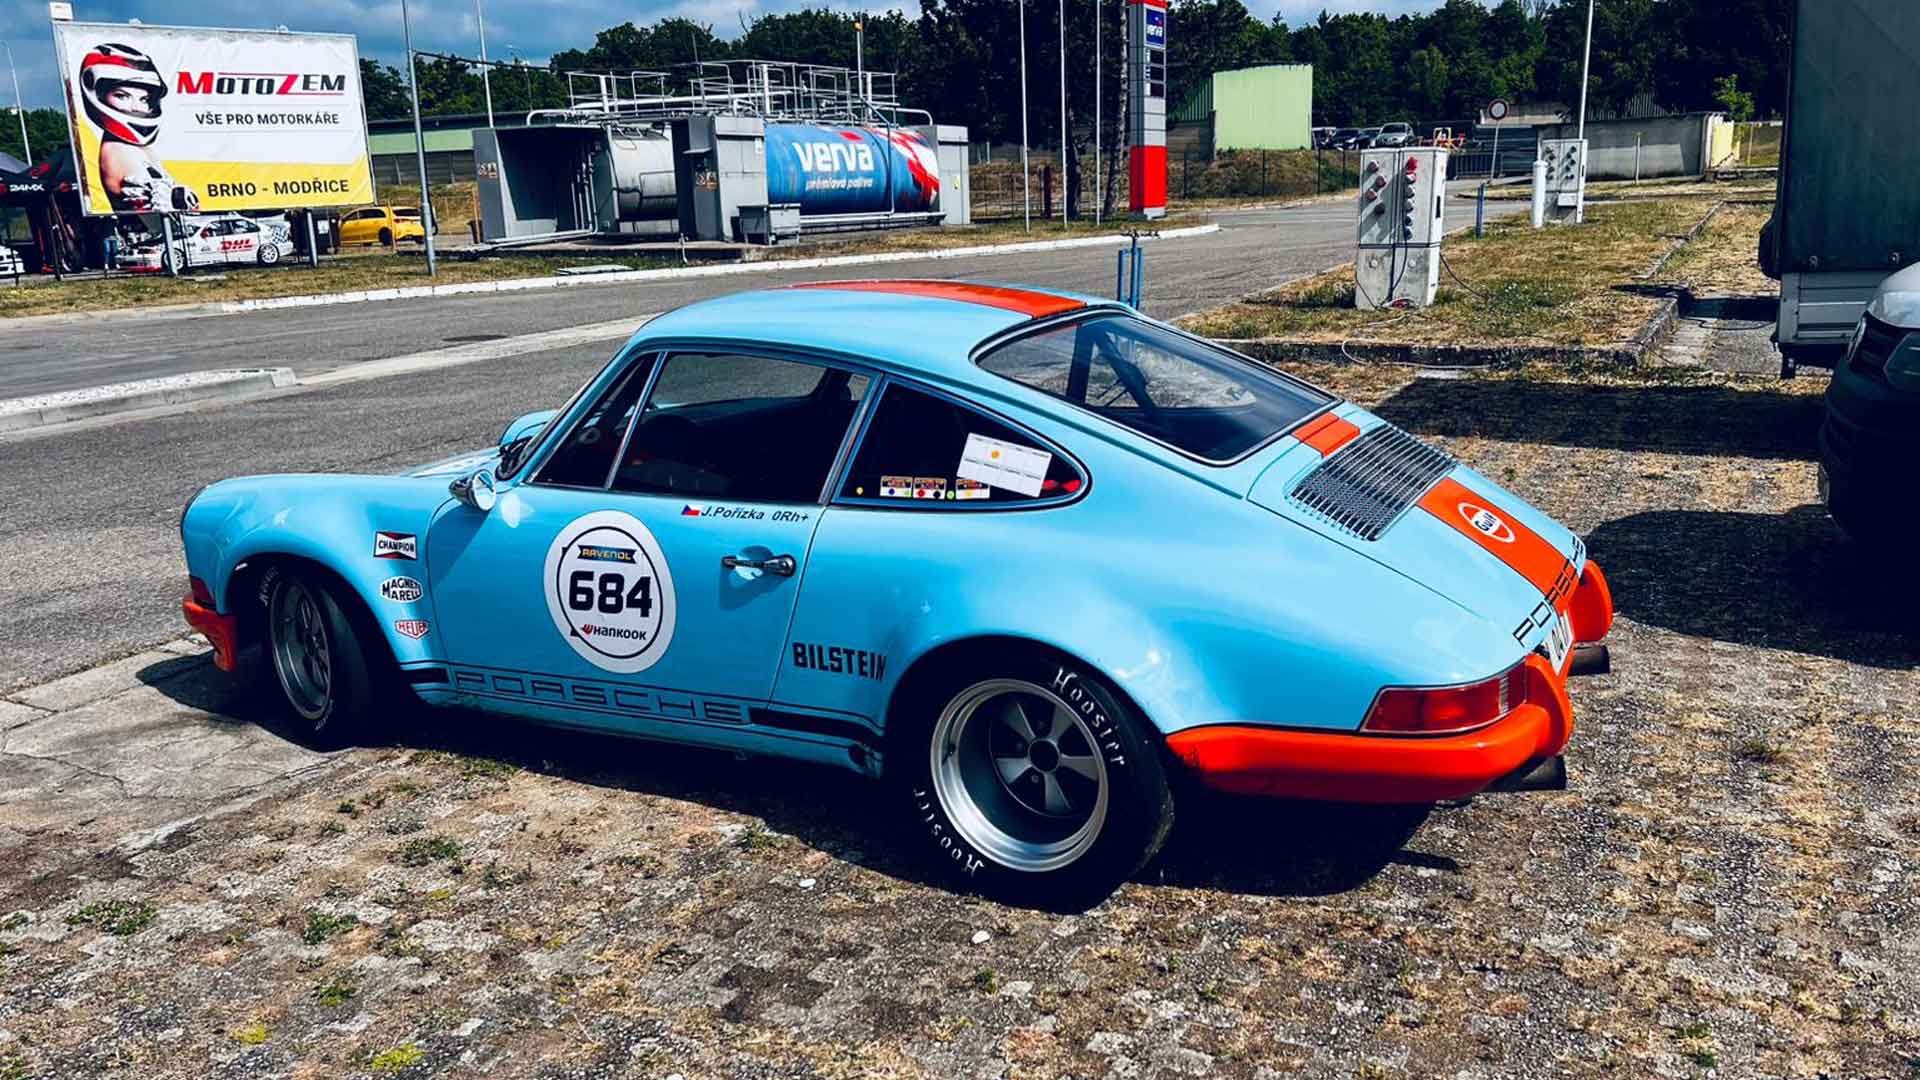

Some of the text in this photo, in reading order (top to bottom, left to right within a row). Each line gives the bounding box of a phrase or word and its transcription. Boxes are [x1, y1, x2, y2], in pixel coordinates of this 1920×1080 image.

[195, 110, 340, 125] VŠE PRO MOTORKÁŘE
[207, 182, 257, 197] BRNO
[273, 177, 349, 195] MODŘICE
[220, 238, 253, 250] DHL
[378, 539, 416, 553] CHAMPION
[581, 548, 632, 561] RAVENOL
[569, 570, 653, 618] 684
[792, 641, 887, 681] BILSTEIN
[455, 671, 746, 723] PORSCHE
